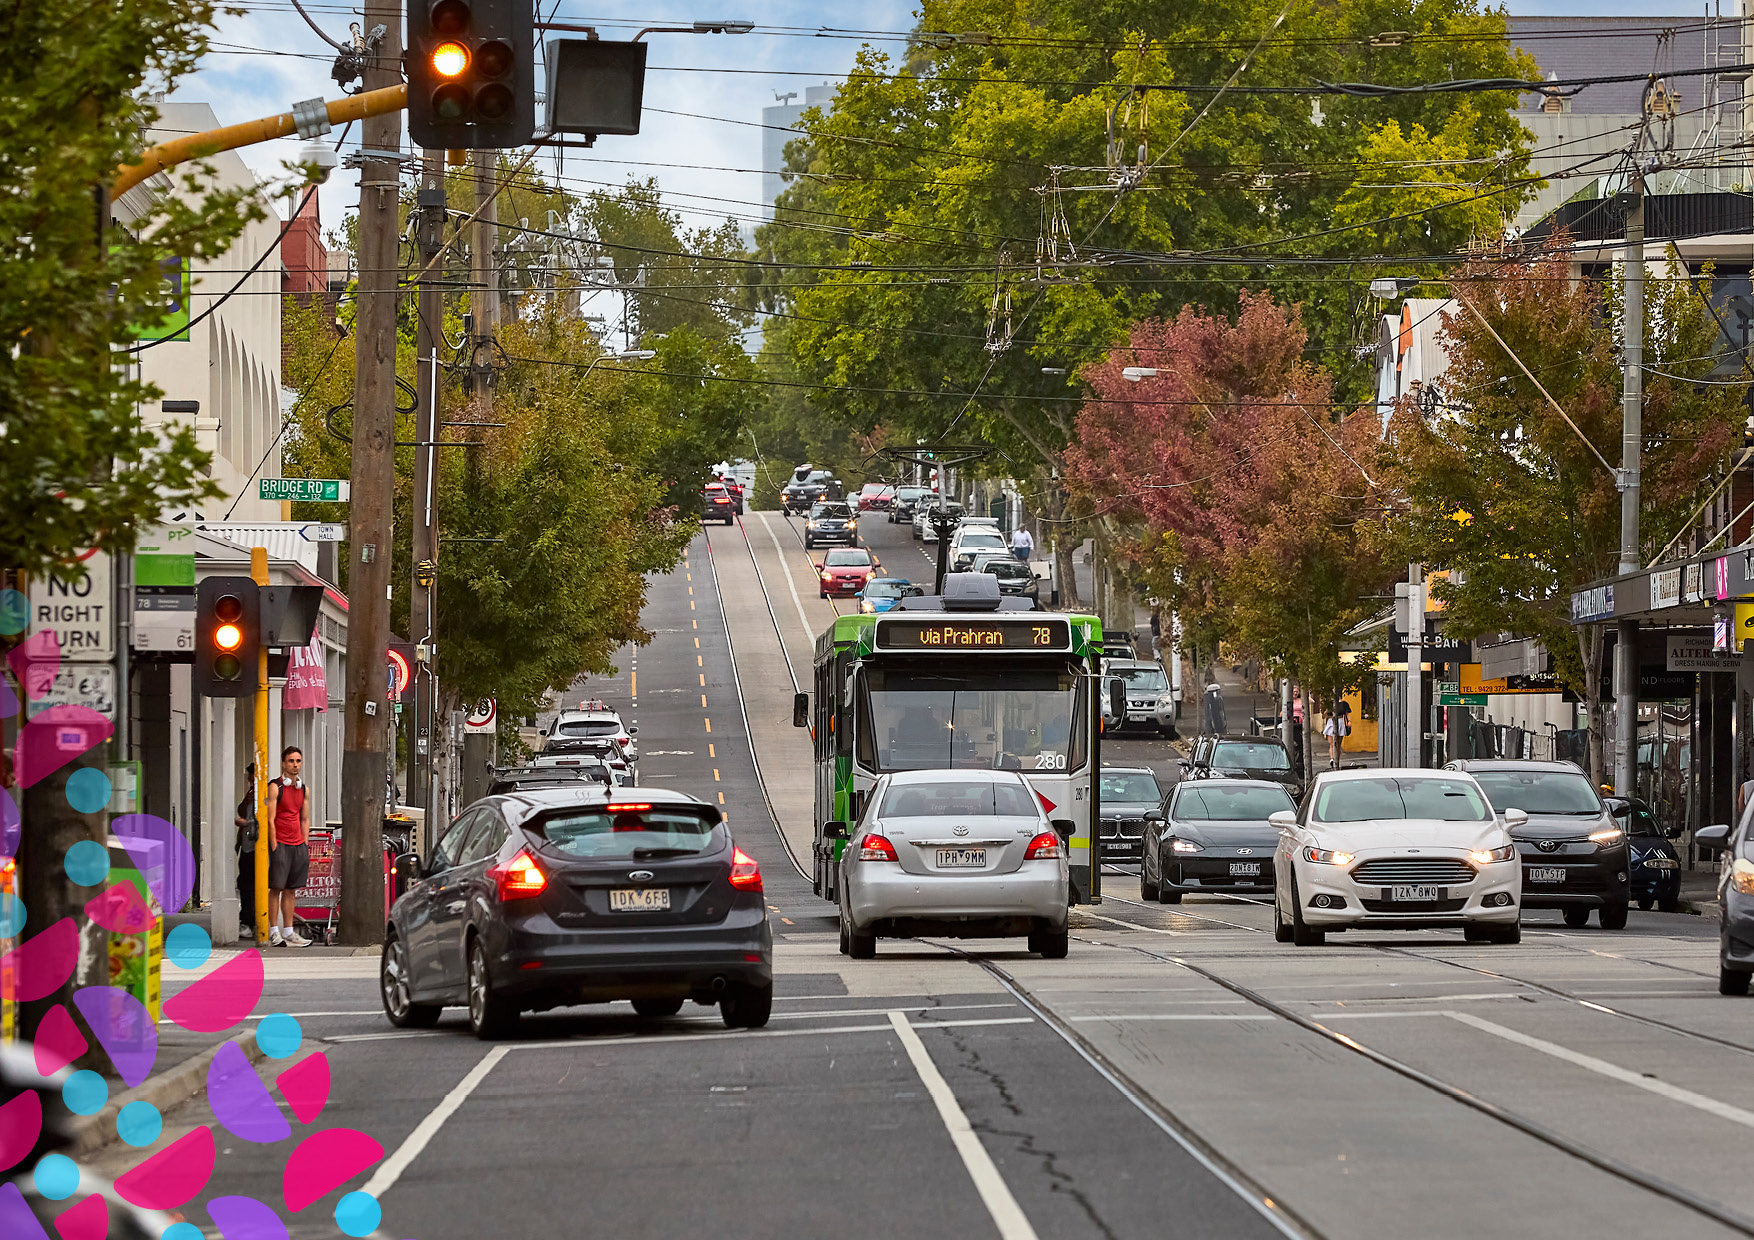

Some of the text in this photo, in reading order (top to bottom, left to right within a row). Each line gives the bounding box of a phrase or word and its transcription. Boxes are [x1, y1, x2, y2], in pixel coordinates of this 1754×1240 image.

[262, 479, 323, 493] BRIDGE RD
[48, 573, 92, 597] NO
[138, 598, 151, 608] 78
[38, 605, 103, 622] RIGHT
[39, 630, 100, 647] TURN
[177, 635, 192, 648] 61
[920, 627, 1051, 645] via Prahran 78
[1400, 636, 1459, 649] WE BAR
[420, 728, 429, 736] 23
[1034, 754, 1066, 770] 280
[939, 851, 985, 863] 1PH 9MM
[1550, 869, 1565, 879] 5TP
[613, 891, 668, 906] 1DK 6FB
[1394, 886, 1412, 898] 1ZK
